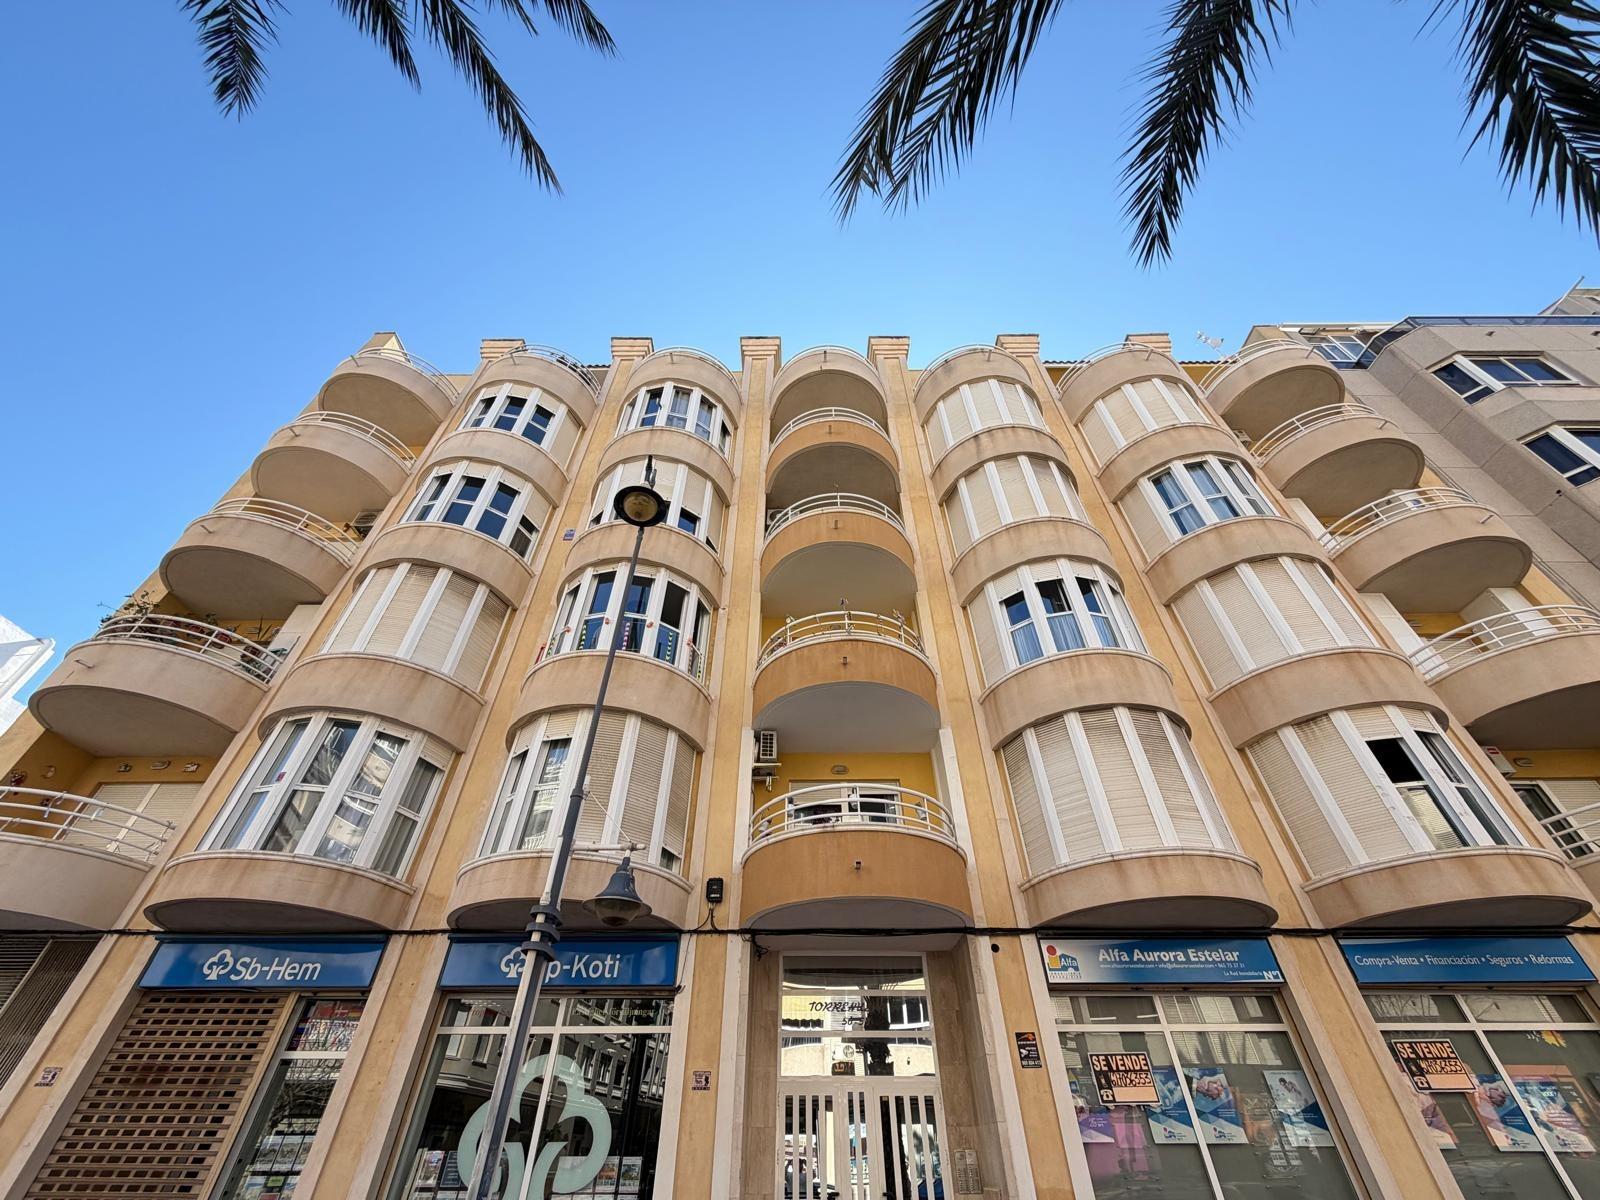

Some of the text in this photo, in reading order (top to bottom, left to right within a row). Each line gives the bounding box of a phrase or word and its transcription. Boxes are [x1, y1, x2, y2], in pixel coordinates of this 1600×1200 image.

[1060, 957, 1079, 967] Alfa
[1098, 948, 1240, 962] Alfa Aurora Estelar
[1354, 953, 1575, 968] Compra-Venta Financiación Seguros Reformas
[229, 956, 321, 981] Sb-Hem
[543, 953, 621, 984] p-Koti
[1396, 1042, 1457, 1059] SE VENDE
[1091, 1055, 1149, 1071] SE VENDE
